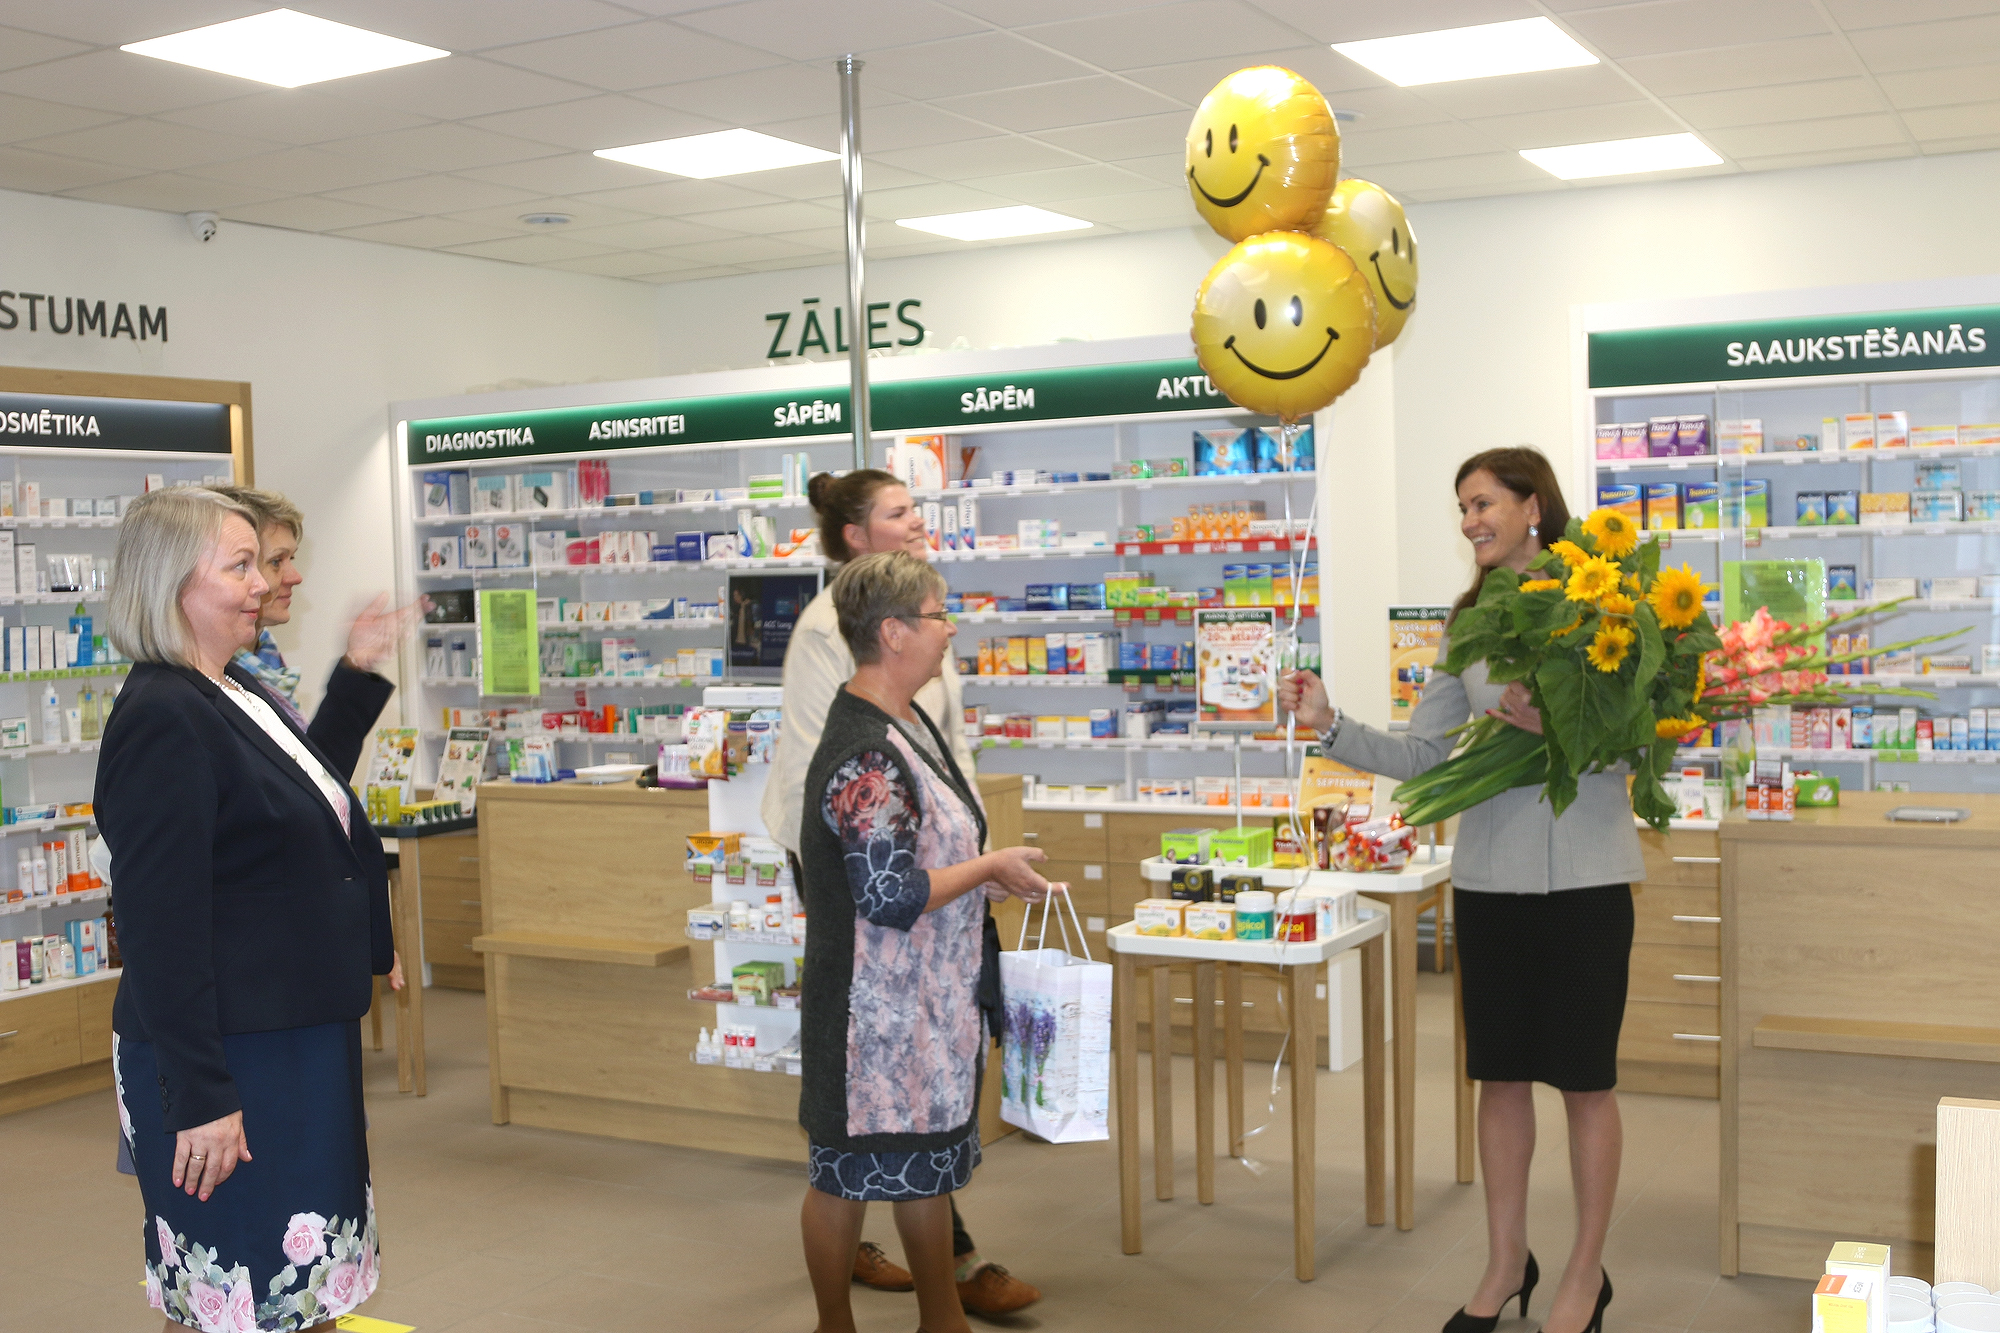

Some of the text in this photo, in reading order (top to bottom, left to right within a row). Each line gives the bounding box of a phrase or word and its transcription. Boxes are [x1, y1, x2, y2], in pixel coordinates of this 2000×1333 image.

[0, 290, 168, 342] STUMAM
[765, 298, 925, 358] ZĀLES
[1726, 323, 1987, 367] SAAUKSTĒŠANĀS
[961, 385, 1034, 413] SĀPĒM
[1155, 375, 1225, 400] AKTU
[588, 414, 686, 440] ASINSRITEI
[774, 400, 841, 427] SĀPĒM
[425, 427, 535, 453] DIAGNOSTIKA
